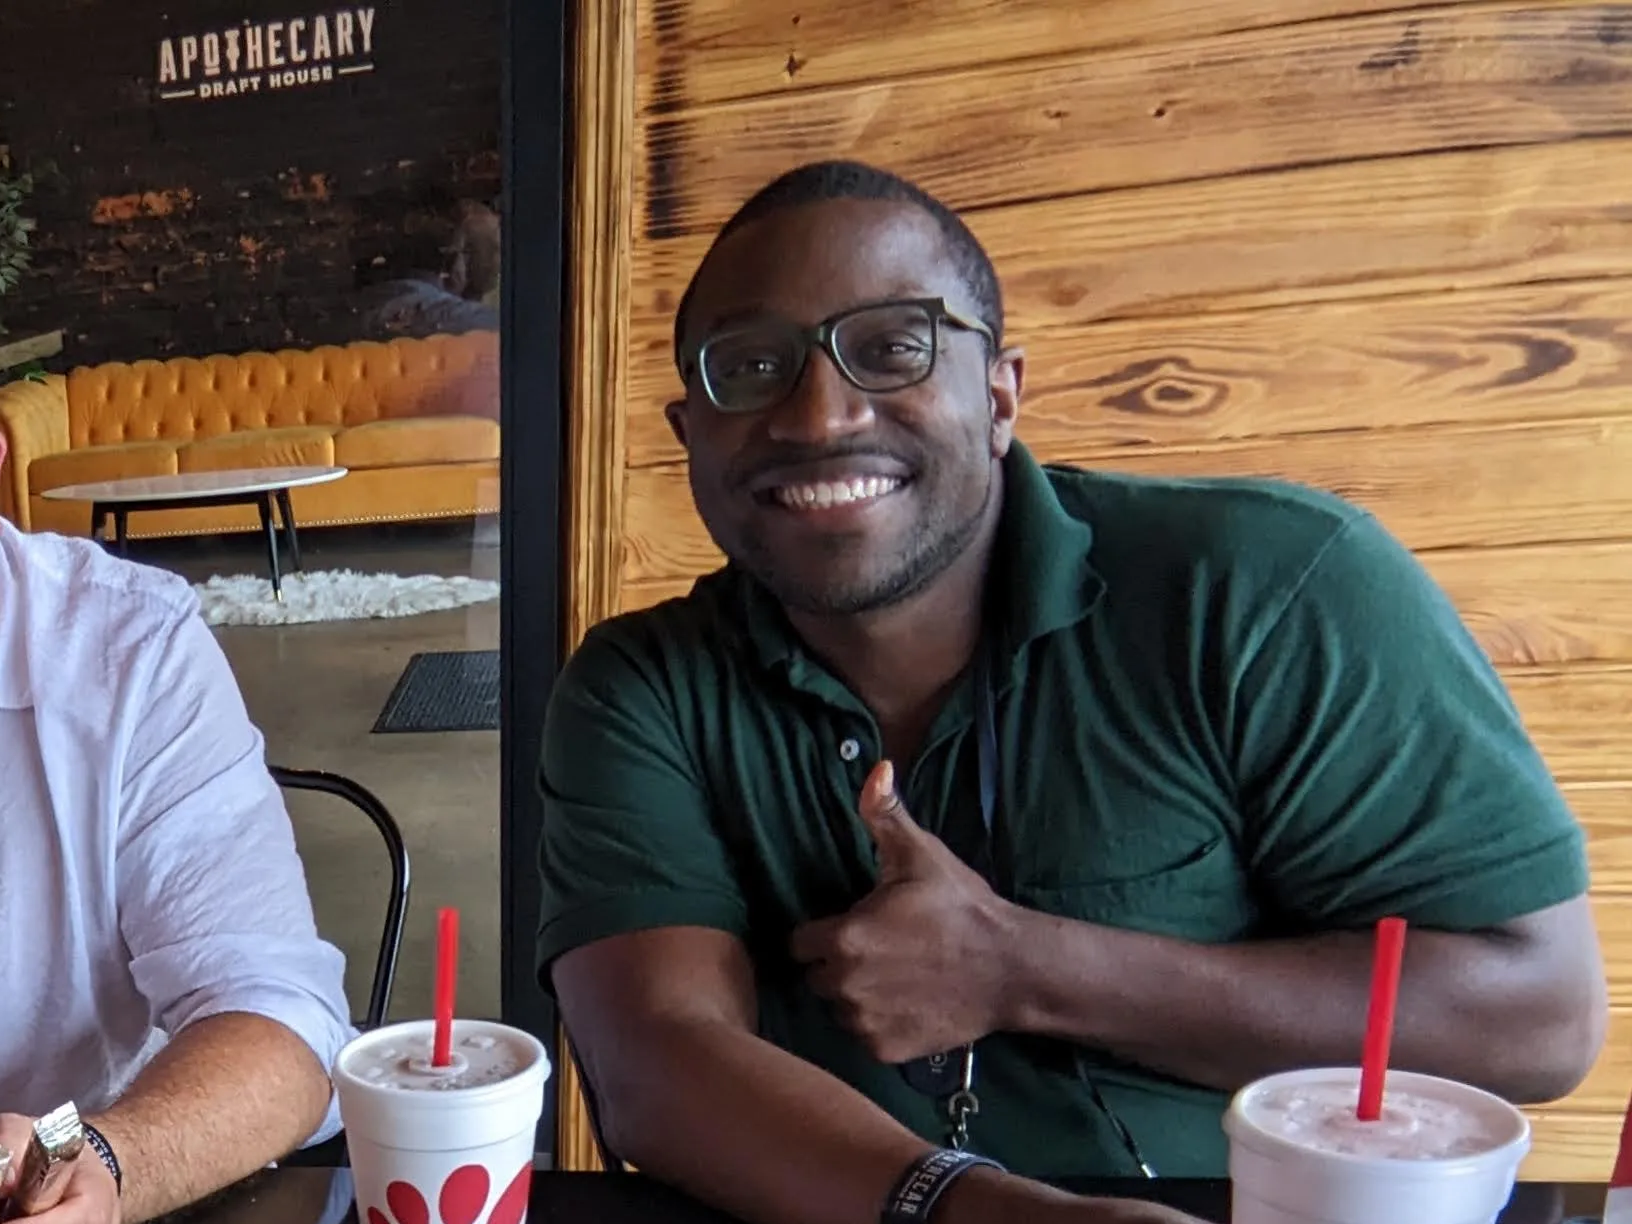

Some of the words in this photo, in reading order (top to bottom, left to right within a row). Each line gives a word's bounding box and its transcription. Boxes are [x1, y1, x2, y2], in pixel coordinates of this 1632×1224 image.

[159, 8, 375, 83] APOTHECARY
[200, 76, 260, 98] DRAFT
[270, 65, 333, 90] HOUSE
